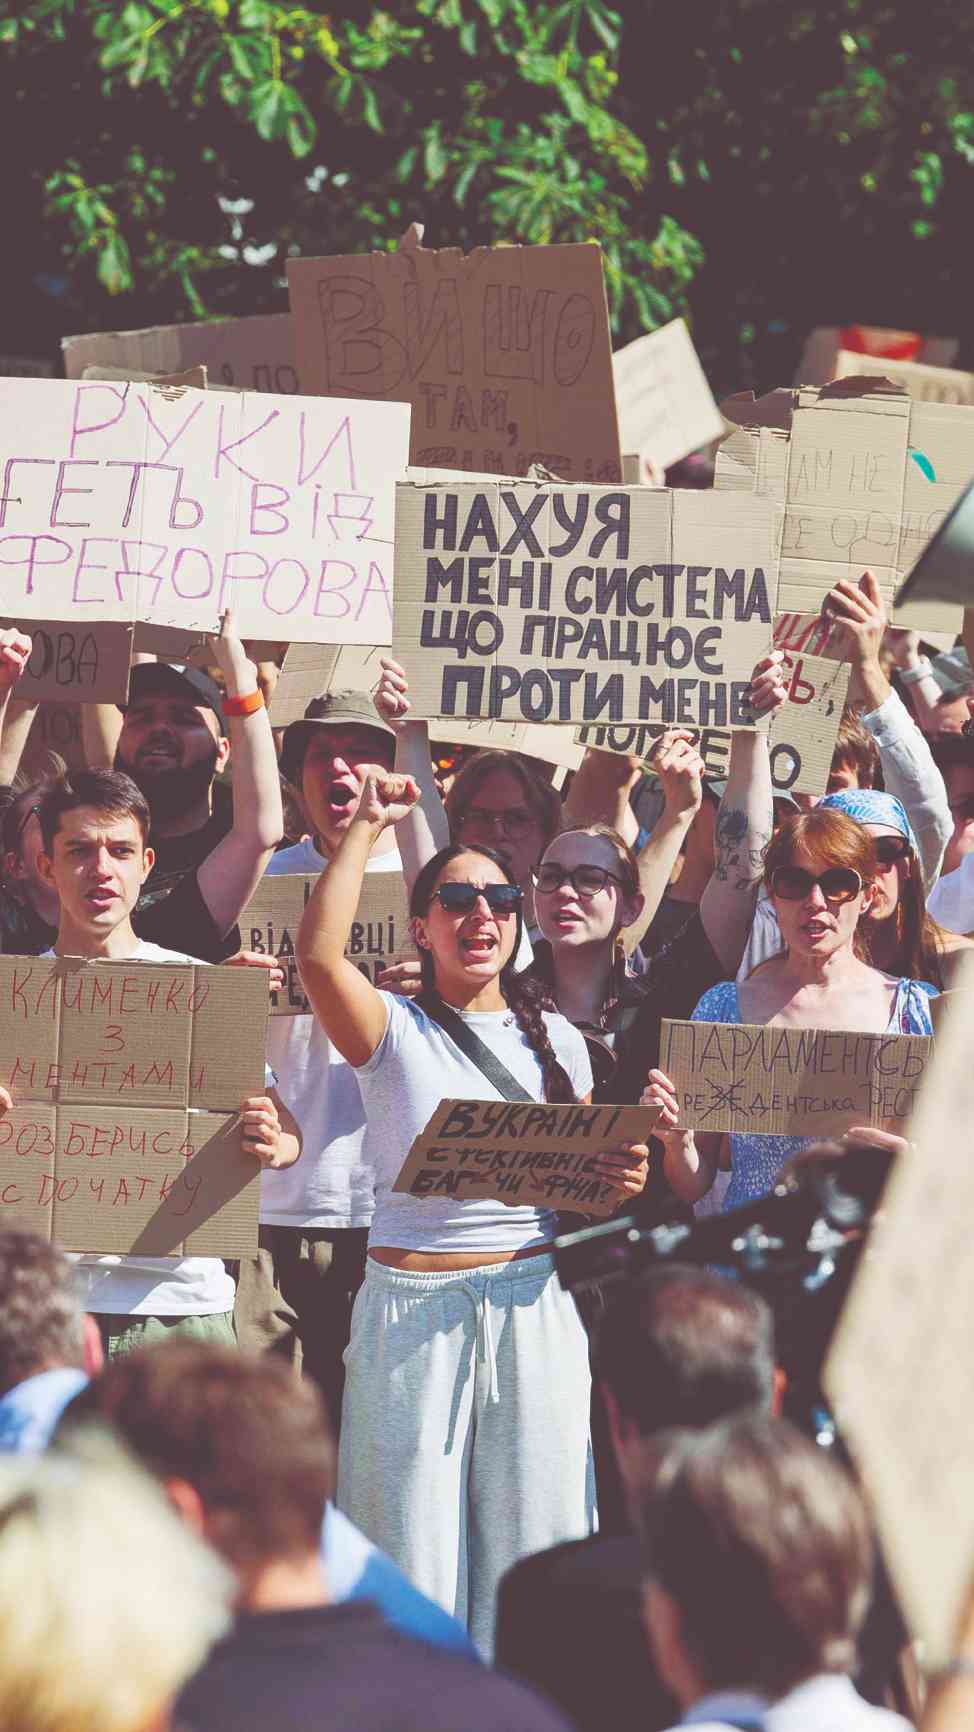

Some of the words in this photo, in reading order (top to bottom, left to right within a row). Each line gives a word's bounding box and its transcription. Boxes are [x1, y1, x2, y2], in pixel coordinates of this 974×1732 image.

[70, 384, 356, 491] РУКИ
[0, 458, 204, 528] ГЕТЬ
[423, 492, 631, 560] НАХУЯ
[0, 534, 394, 621] ФЕДОРОВА
[423, 557, 553, 611] МЕНІ
[564, 563, 772, 623] СИСТЕМА
[420, 609, 504, 659] ЩО
[519, 614, 724, 675] ПРАЦЮЄ
[440, 665, 624, 722] ПРОТИ
[638, 674, 757, 728] МЕНЕ
[12, 967, 210, 1020] КЛИМЕНКО
[9, 1056, 207, 1092] МЕНТАМИ
[666, 1022, 935, 1077] ПАРЛАМЕНТСЬ
